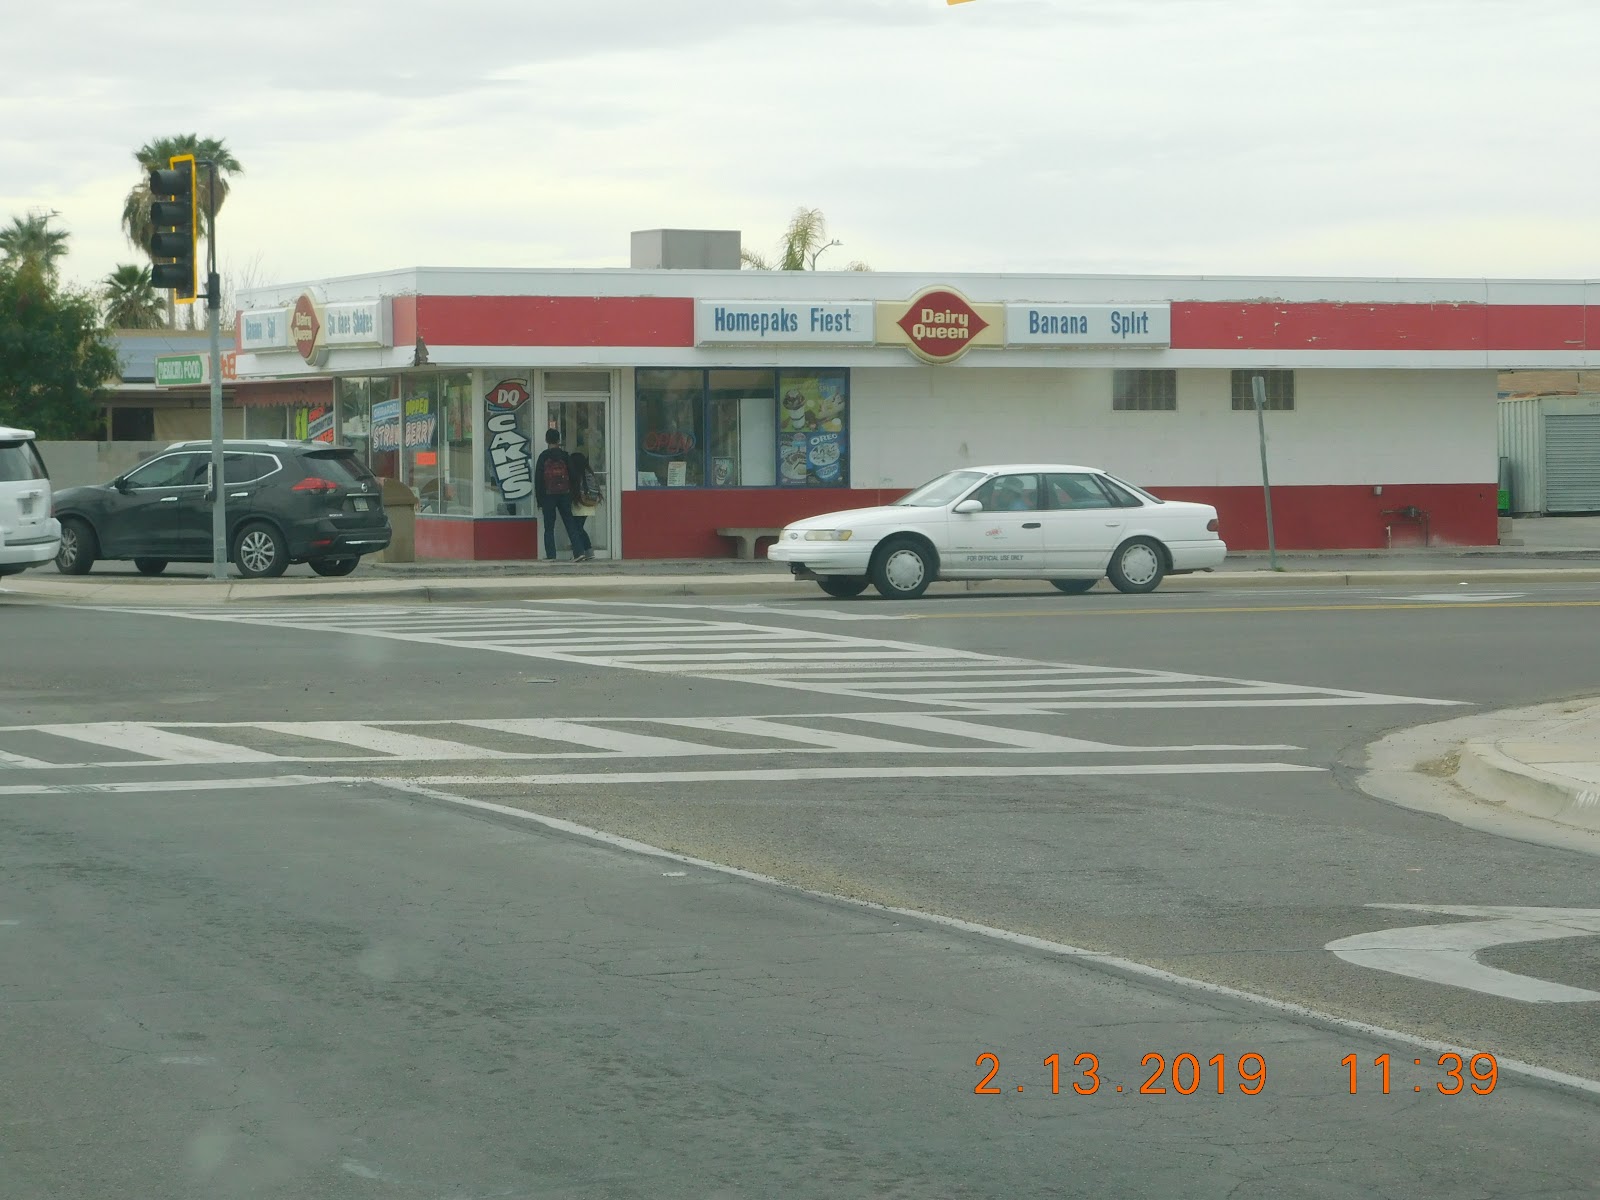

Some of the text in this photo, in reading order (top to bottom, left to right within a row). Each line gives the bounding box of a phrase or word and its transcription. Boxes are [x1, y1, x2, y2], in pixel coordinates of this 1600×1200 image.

[296, 312, 312, 328] Dairy
[714, 307, 851, 336] Homepaks Fiest
[921, 308, 969, 327] Dairy
[1029, 310, 1149, 339] Banana Split
[294, 327, 313, 341] Queen
[912, 323, 969, 340] Queen
[183, 360, 201, 379] FOOD
[497, 389, 520, 406] DQ
[405, 418, 436, 448] BERRY
[810, 433, 838, 446] OREO
[487, 413, 532, 499] CAKES
